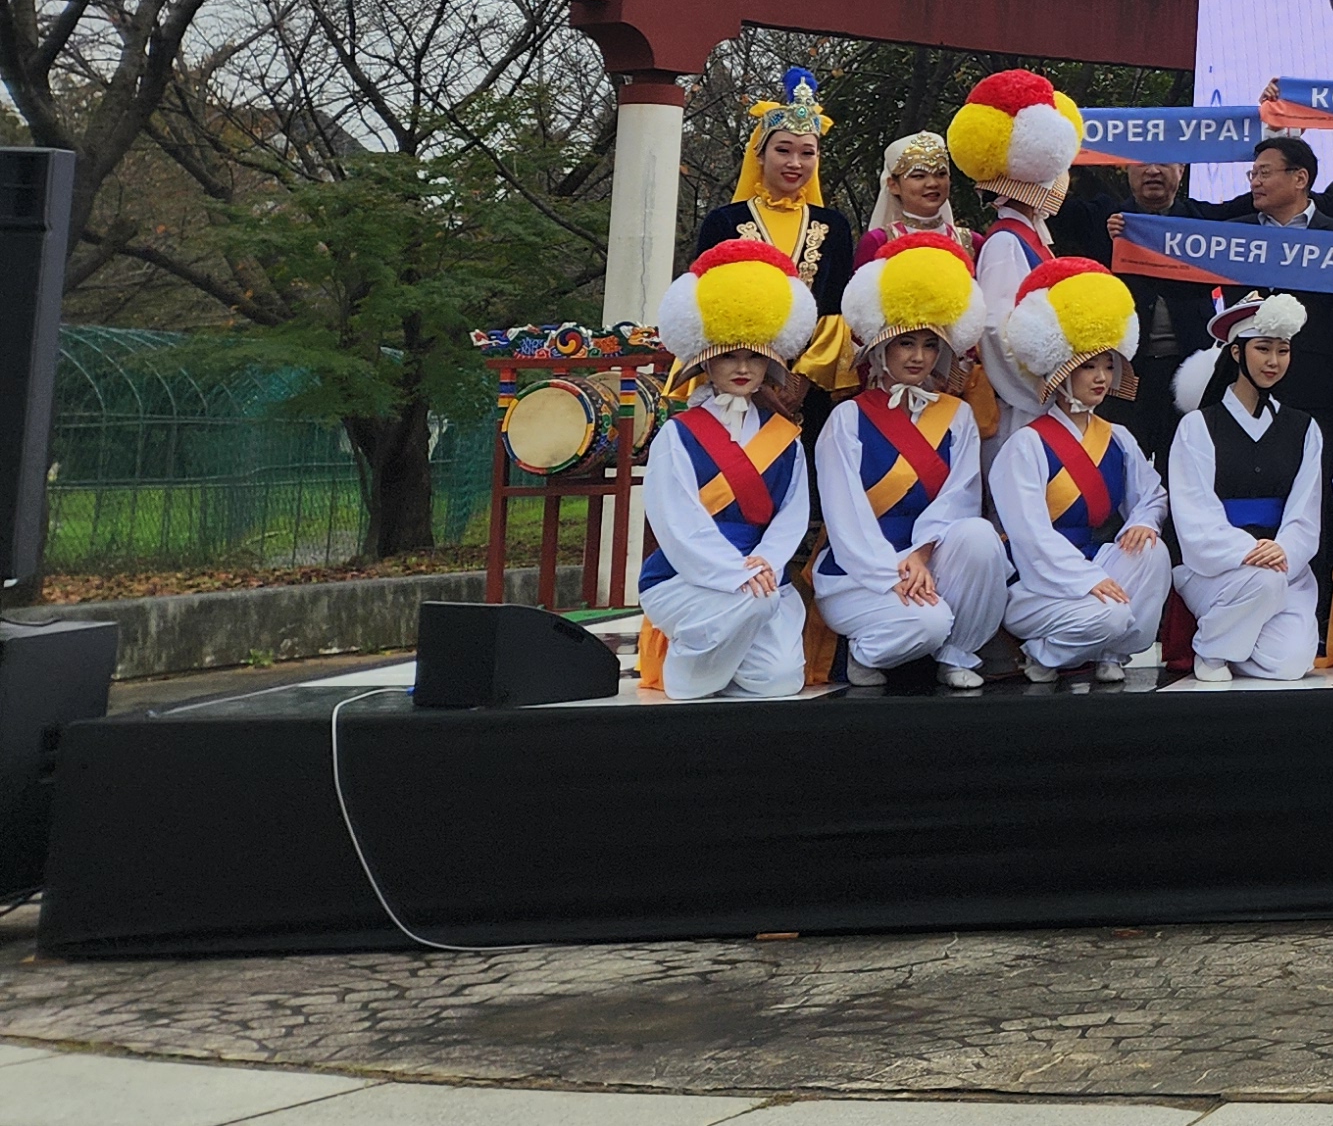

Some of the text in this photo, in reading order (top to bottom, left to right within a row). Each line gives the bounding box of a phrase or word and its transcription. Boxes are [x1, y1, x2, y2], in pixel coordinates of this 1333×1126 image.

[1083, 118, 1251, 142] ОРЕЯ УРА!
[1165, 232, 1268, 264] КОРЕЯ
